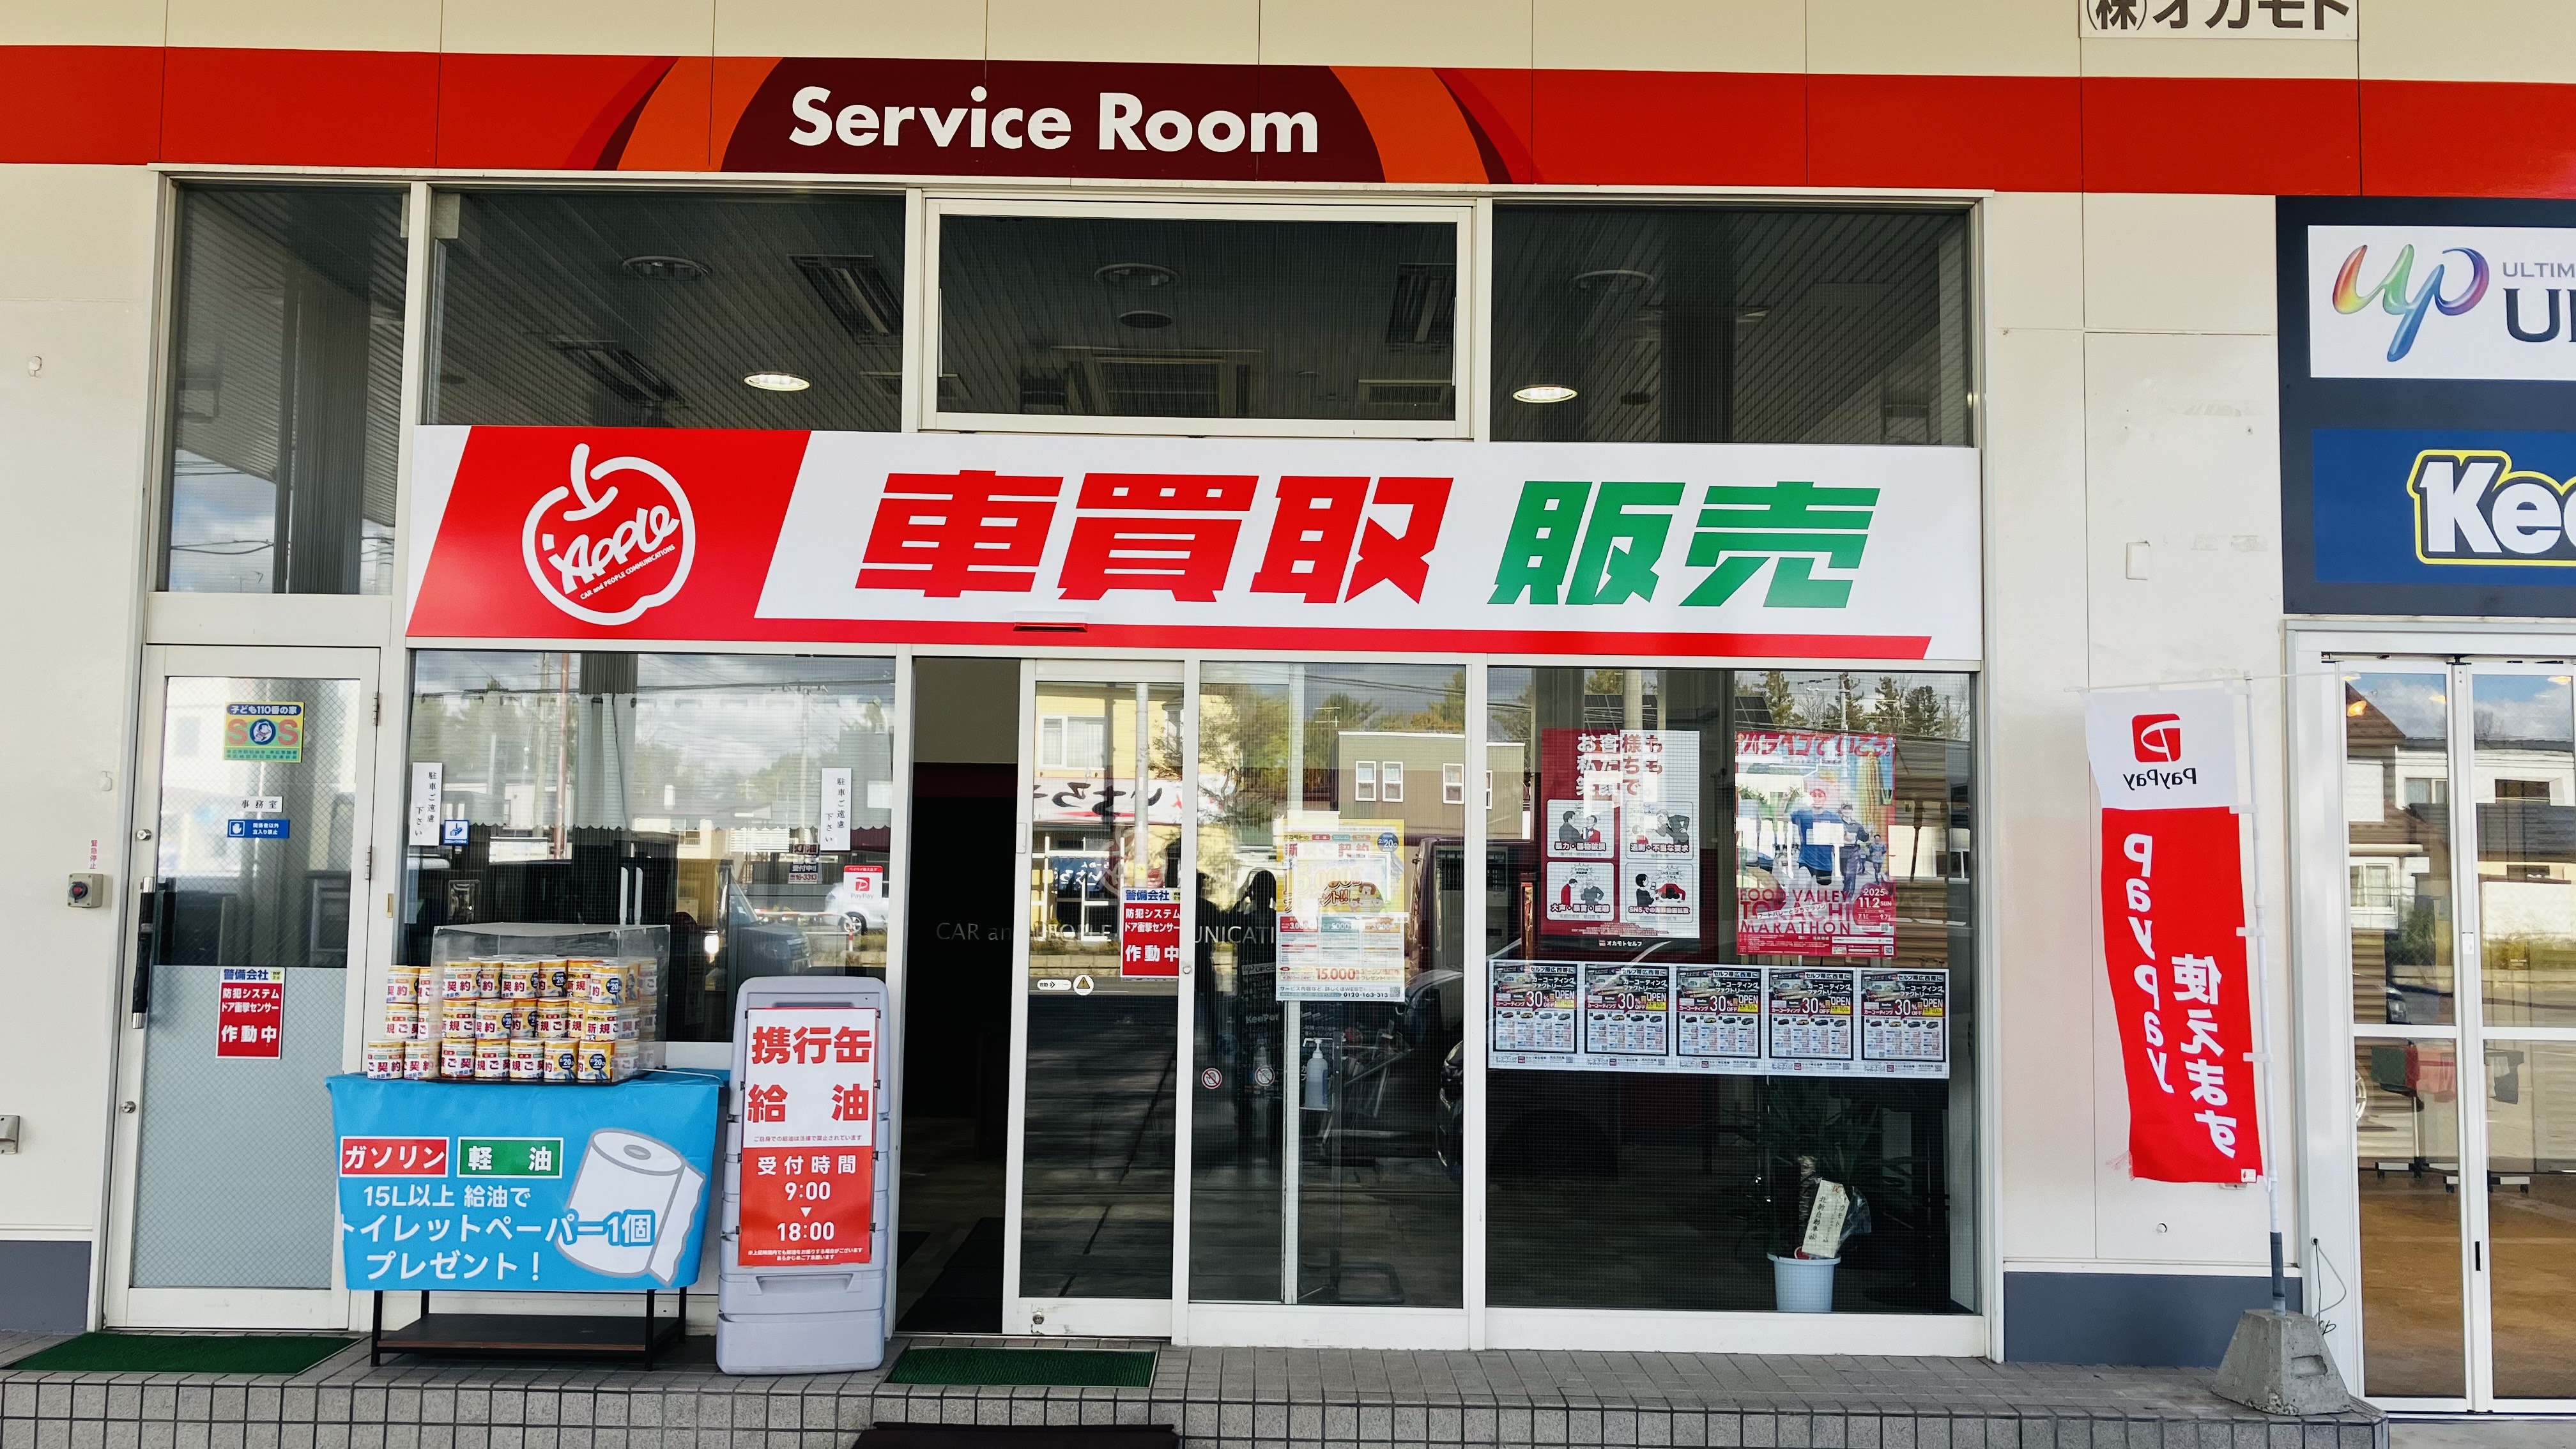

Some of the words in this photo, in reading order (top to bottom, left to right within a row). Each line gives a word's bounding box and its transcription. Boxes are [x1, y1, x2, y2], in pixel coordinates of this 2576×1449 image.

[789, 86, 1071, 149] Service
[1099, 92, 1318, 153] Room
[2503, 288, 2576, 343] U
[2419, 461, 2576, 554] Ke
[854, 470, 1454, 604] 車買取
[1488, 480, 1881, 609] 販売
[580, 589, 594, 600] CAR
[593, 583, 604, 594] and
[604, 571, 626, 589] PEOPLE
[625, 544, 675, 576] COMMUNICATIONS
[230, 706, 297, 714] 子ども110番の家
[1577, 733, 1662, 753] お客様も
[1577, 755, 1662, 775] 私たちも
[241, 800, 277, 809] 事務室
[427, 771, 437, 823] 駐車ご遠慮
[837, 778, 845, 829] 駐車ご遠慮
[415, 806, 424, 836] 下さい
[1126, 890, 1170, 901] 警備会社
[1740, 889, 1786, 901] FOOD
[1793, 889, 1850, 902] VALLEY
[1864, 888, 1885, 896] 2025
[1858, 897, 1880, 908] 11.2
[1125, 908, 1181, 919] 防犯システム
[937, 923, 979, 940] CAR
[1124, 922, 1181, 933] ドア衝撃センサー
[1740, 920, 1850, 935] MARATHON
[1125, 945, 1180, 962] 作動中
[224, 969, 268, 980] 警備会社
[1316, 968, 1356, 980] 15,000
[222, 988, 280, 999] 防犯システム
[1526, 991, 1542, 1007] 30
[1555, 990, 1574, 999] OPEN
[1618, 993, 1634, 1009] 30
[1647, 993, 1666, 1001] OPEN
[1738, 995, 1758, 1004] OPEN
[1831, 997, 1850, 1006] OPEN
[222, 1002, 279, 1013] ドア衝撃センサー
[1710, 995, 1726, 1011] 30
[1802, 997, 1818, 1013] 30
[1894, 999, 1910, 1015] 30
[1923, 999, 1942, 1008] OPEN
[221, 1025, 277, 1043] 作動中
[751, 1025, 872, 1064] 携行缶
[747, 1084, 869, 1123] 給油
[344, 1146, 445, 1170] ガソリン
[468, 1146, 552, 1172] 軽油
[757, 1155, 856, 1176] 受付時間
[364, 1184, 455, 1208] 15L以上
[464, 1186, 532, 1208] 給油で
[785, 1181, 831, 1201] 9:00
[342, 1213, 652, 1245] トイレットペーパー1個
[777, 1222, 835, 1242] 18:00
